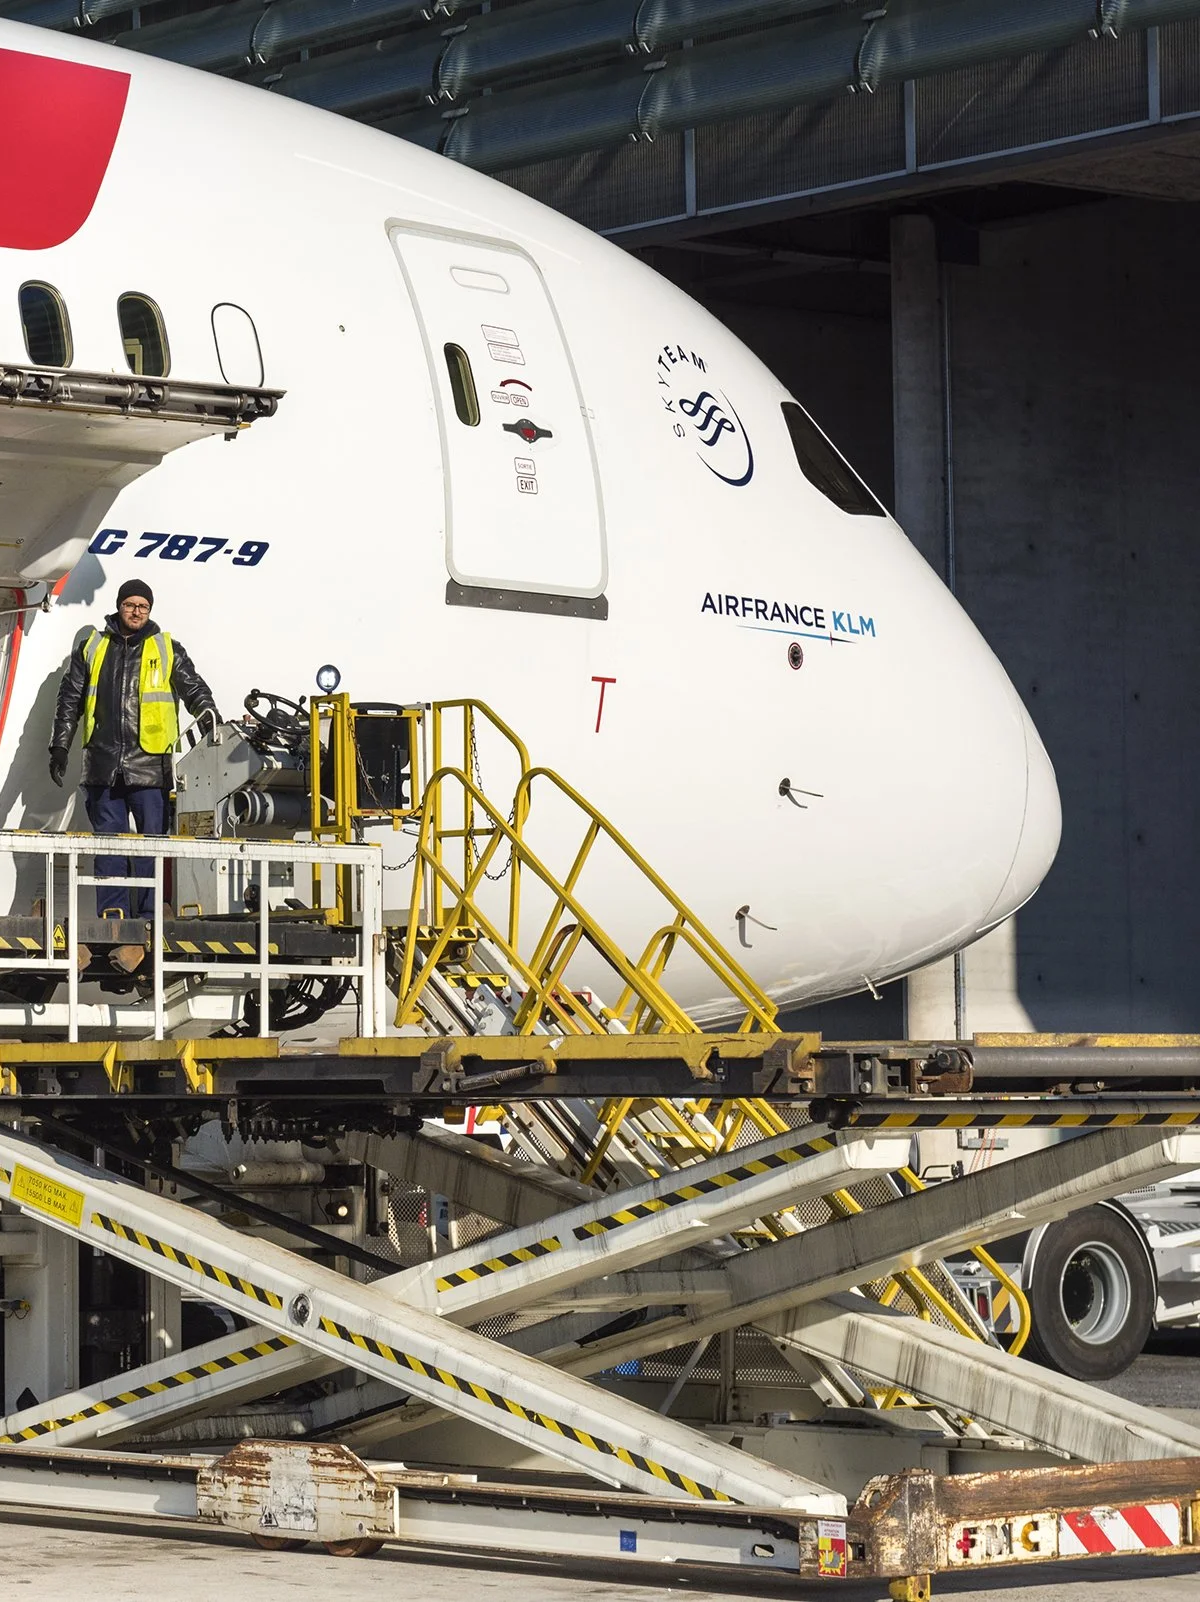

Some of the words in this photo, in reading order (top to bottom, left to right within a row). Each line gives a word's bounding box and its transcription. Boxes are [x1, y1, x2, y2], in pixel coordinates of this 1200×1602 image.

[657, 345, 706, 438] SKYTEAM
[513, 396, 527, 405] OPEN
[517, 463, 533, 471] SORTIE
[519, 479, 534, 491] EXIT
[134, 531, 270, 567] 787-9
[701, 592, 826, 629] AIRFRANCE
[831, 610, 876, 637] KLM
[28, 1176, 43, 1188] 7050
[43, 1183, 52, 1193] KG
[26, 1188, 42, 1201] 15500
[44, 1196, 52, 1205] LB
[963, 1521, 1040, 1559] FMC
